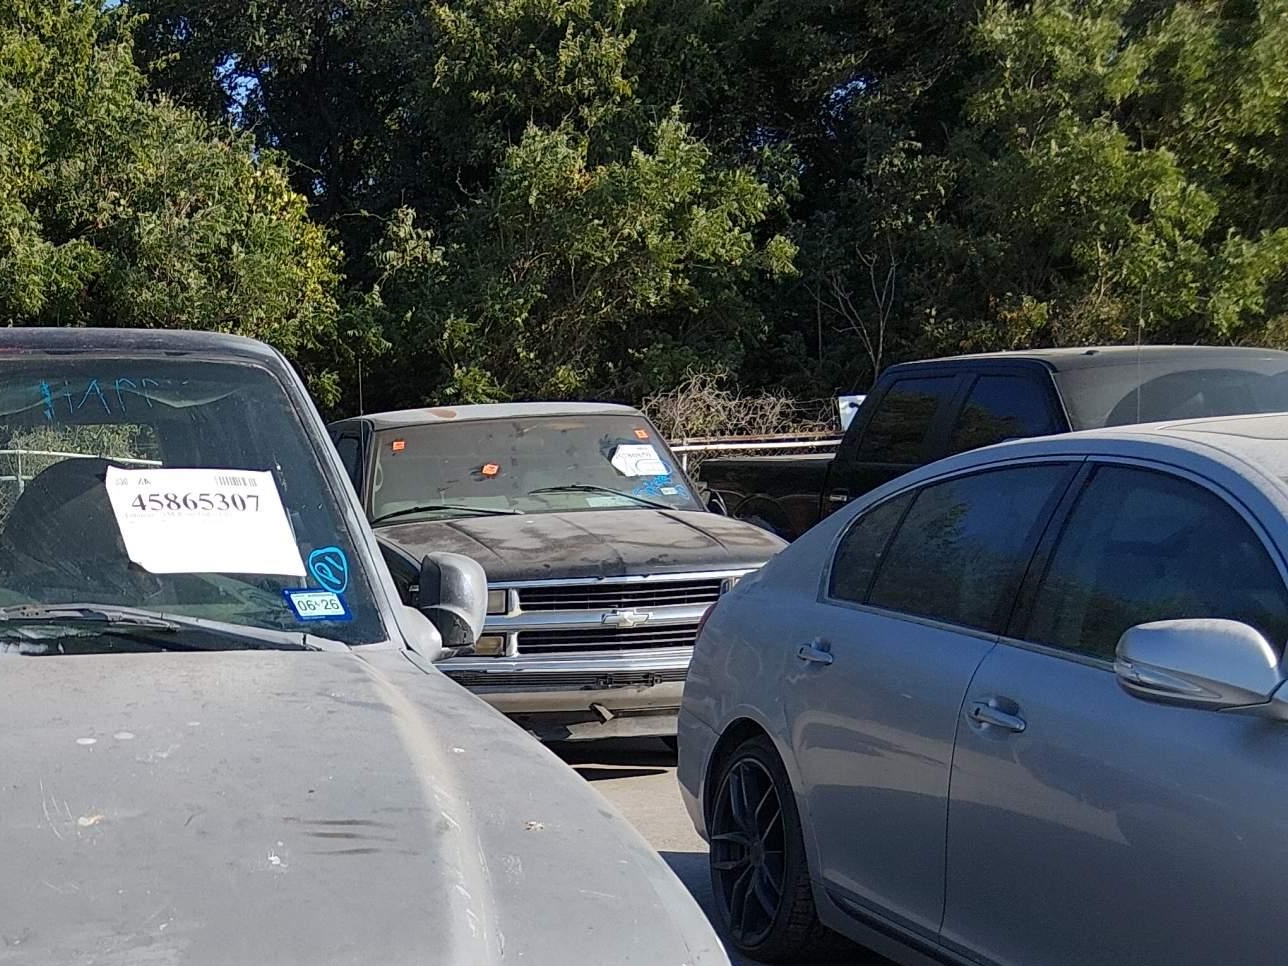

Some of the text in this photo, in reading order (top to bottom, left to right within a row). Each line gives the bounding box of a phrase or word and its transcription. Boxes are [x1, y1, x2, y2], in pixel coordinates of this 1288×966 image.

[132, 492, 260, 512] 45865307
[297, 598, 340, 612] 06 26
